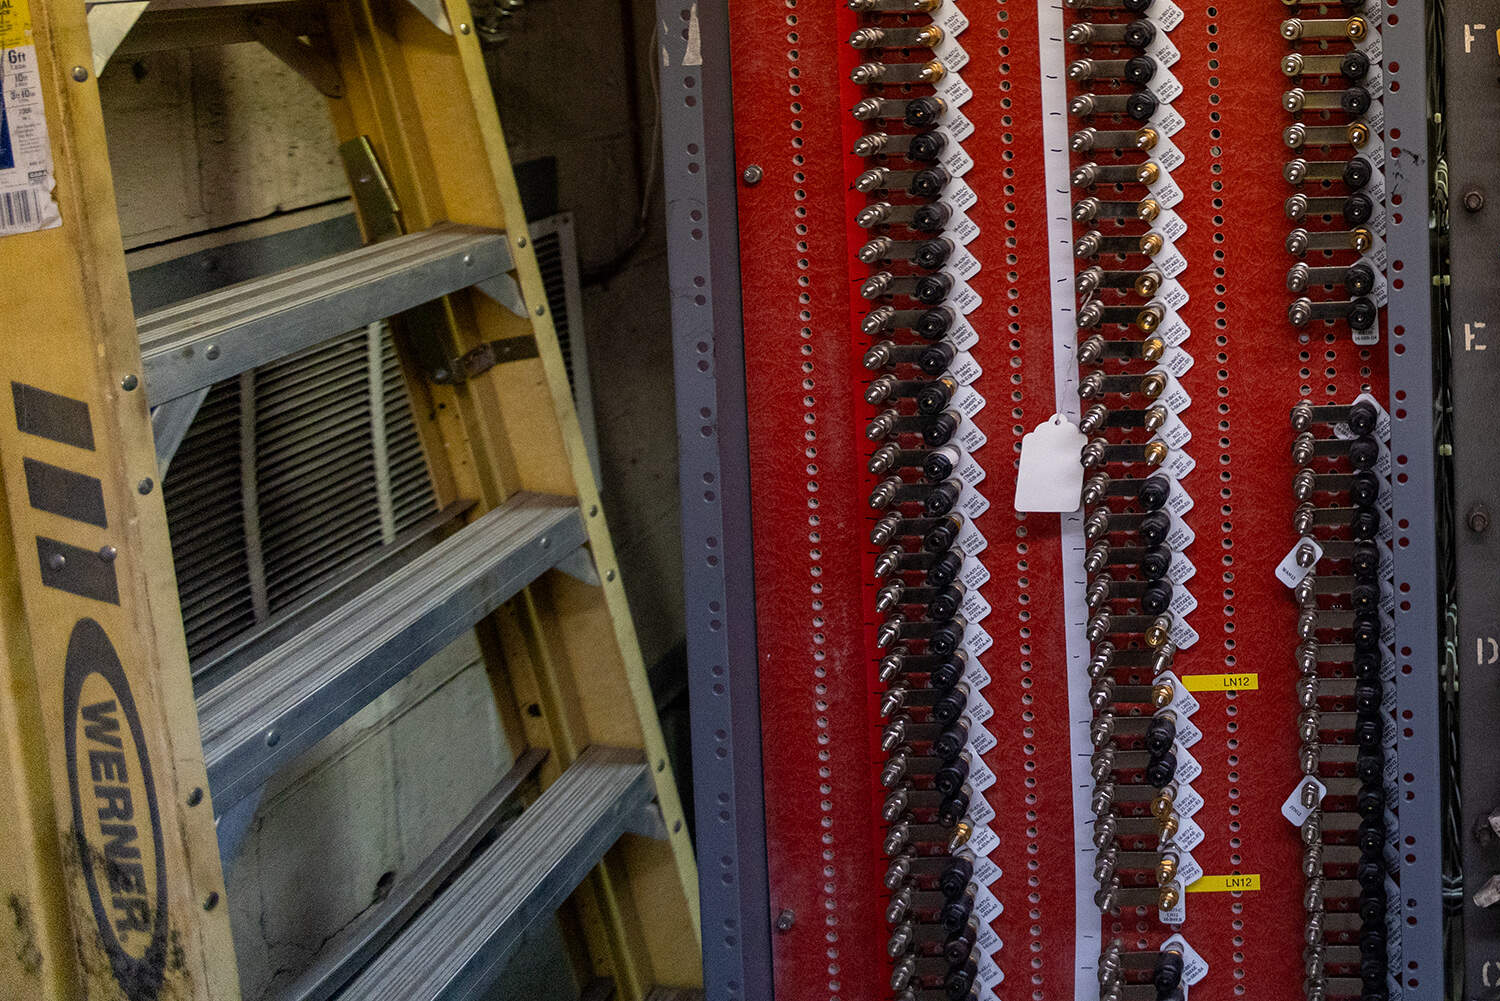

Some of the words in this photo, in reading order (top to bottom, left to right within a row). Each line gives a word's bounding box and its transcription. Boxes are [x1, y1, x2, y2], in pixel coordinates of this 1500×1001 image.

[1464, 24, 1486, 53] F
[1464, 322, 1487, 351] E
[1477, 638, 1498, 664] D
[1222, 676, 1250, 688] LN12
[80, 700, 152, 943] WERNER
[1225, 877, 1252, 889] LN12
